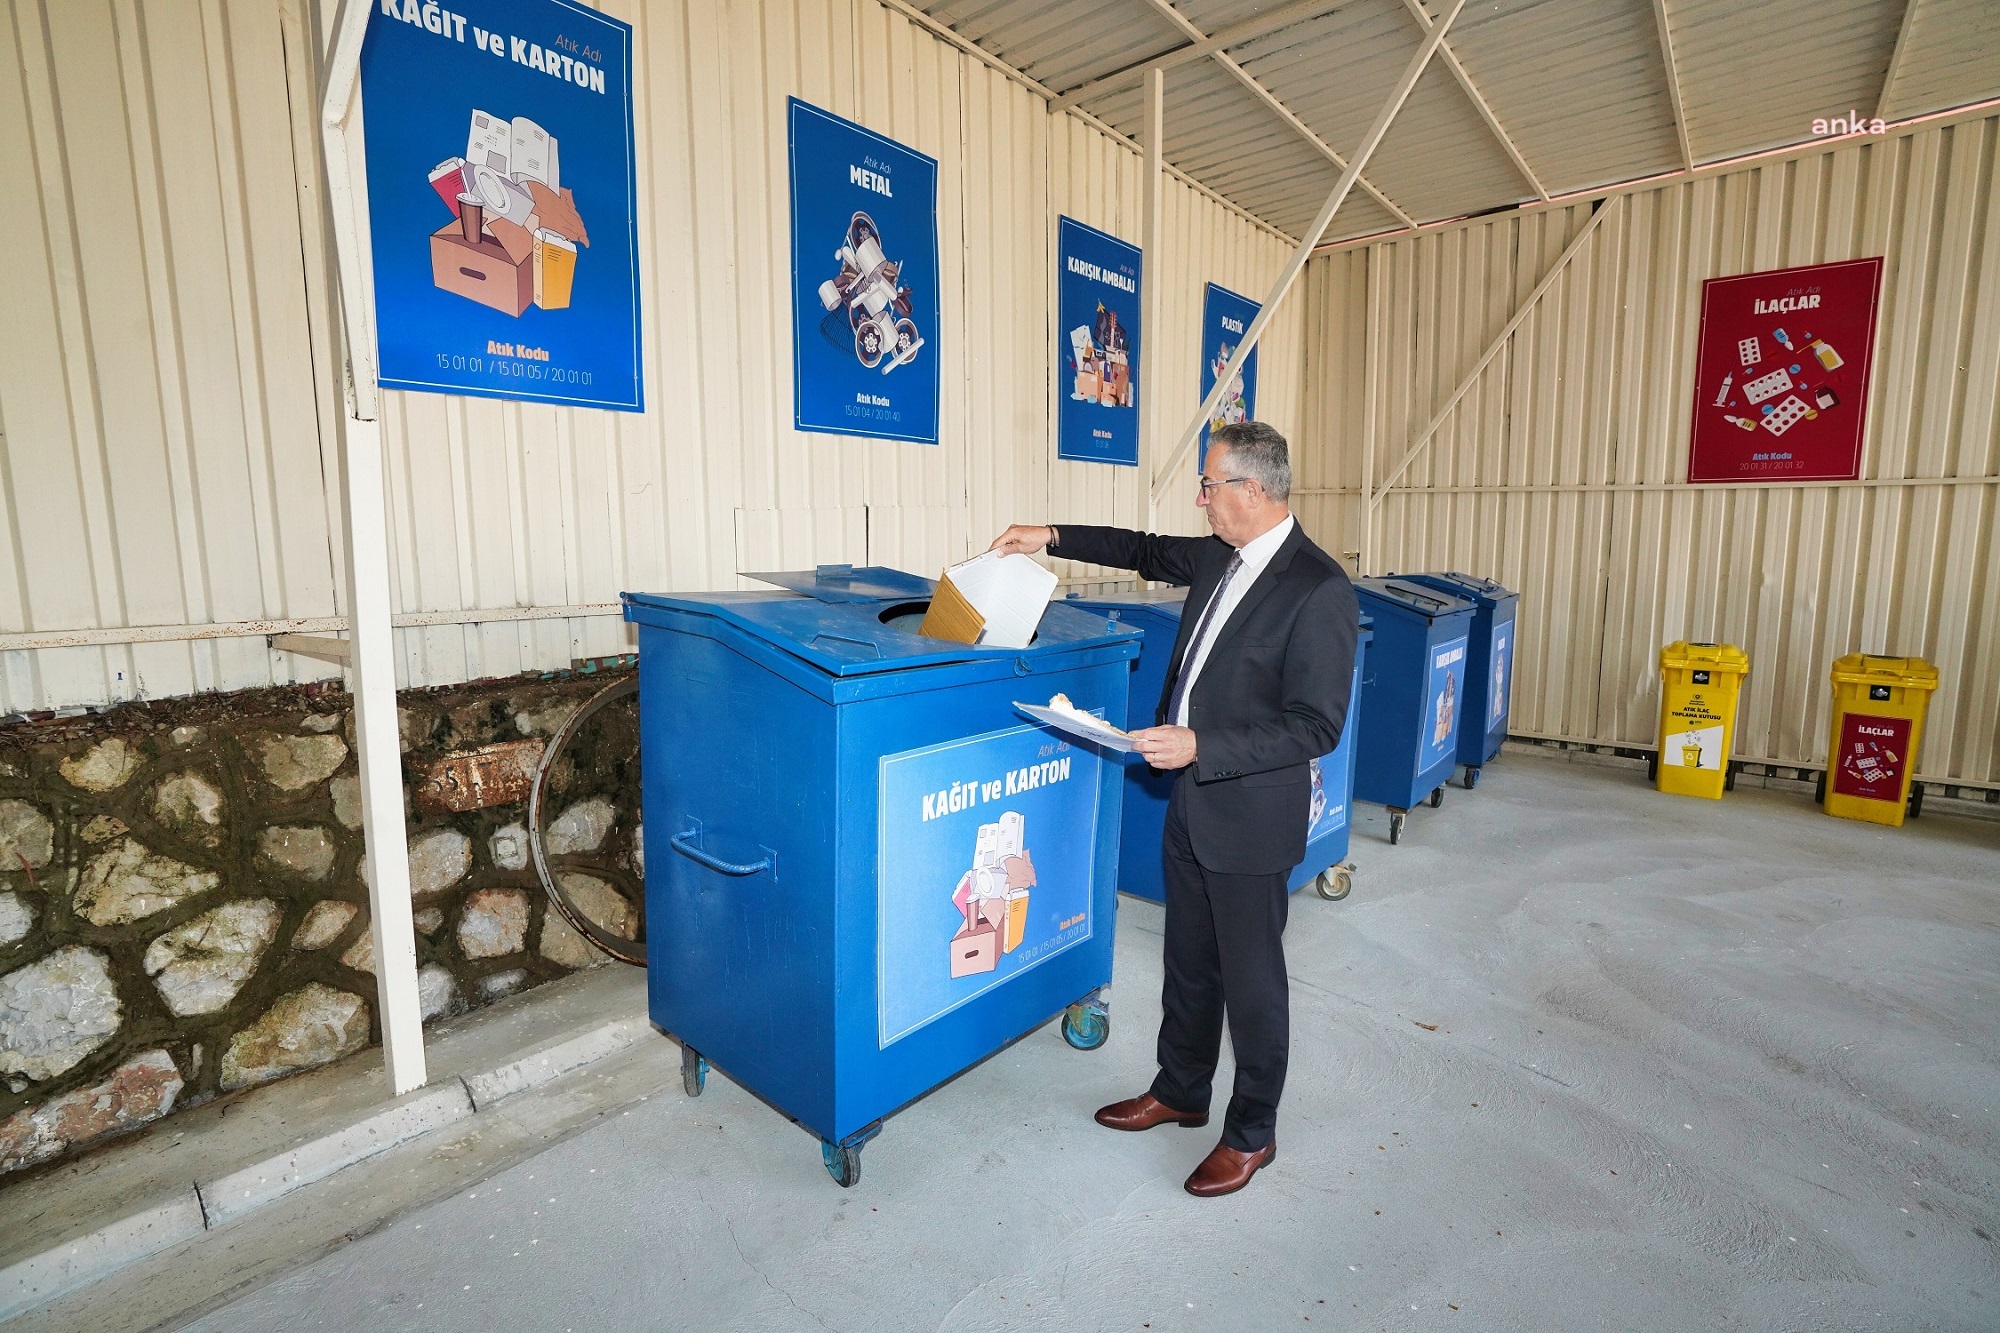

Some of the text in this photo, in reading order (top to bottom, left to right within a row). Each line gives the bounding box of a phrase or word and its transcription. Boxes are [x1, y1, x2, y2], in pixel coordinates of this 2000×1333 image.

[381, 0, 605, 95] KAĞIT ve KARTON
[555, 34, 602, 63] Atık Adı
[864, 155, 892, 174] Atık Adı
[850, 164, 893, 198] METAL
[1067, 255, 1101, 281] KARIŞIK
[1102, 268, 1135, 294] AMBALAJ
[1753, 294, 1821, 314] İLAÇLAR
[1221, 315, 1244, 335] PLASTİK
[487, 340, 550, 362] Atık Kodu
[436, 353, 592, 385] 15 01 01 / 15 01 05 / 20 01 01
[856, 392, 890, 407] Atık Kodu
[845, 404, 852, 416] 15
[1740, 462, 1749, 470] 20
[1774, 461, 1784, 470] 20
[1671, 711, 1698, 719] TOPLAMA
[1858, 724, 1895, 737] İLAÇLAR
[1038, 744, 1054, 758] Atık
[922, 756, 1071, 822] KAĞIT ve KARTON
